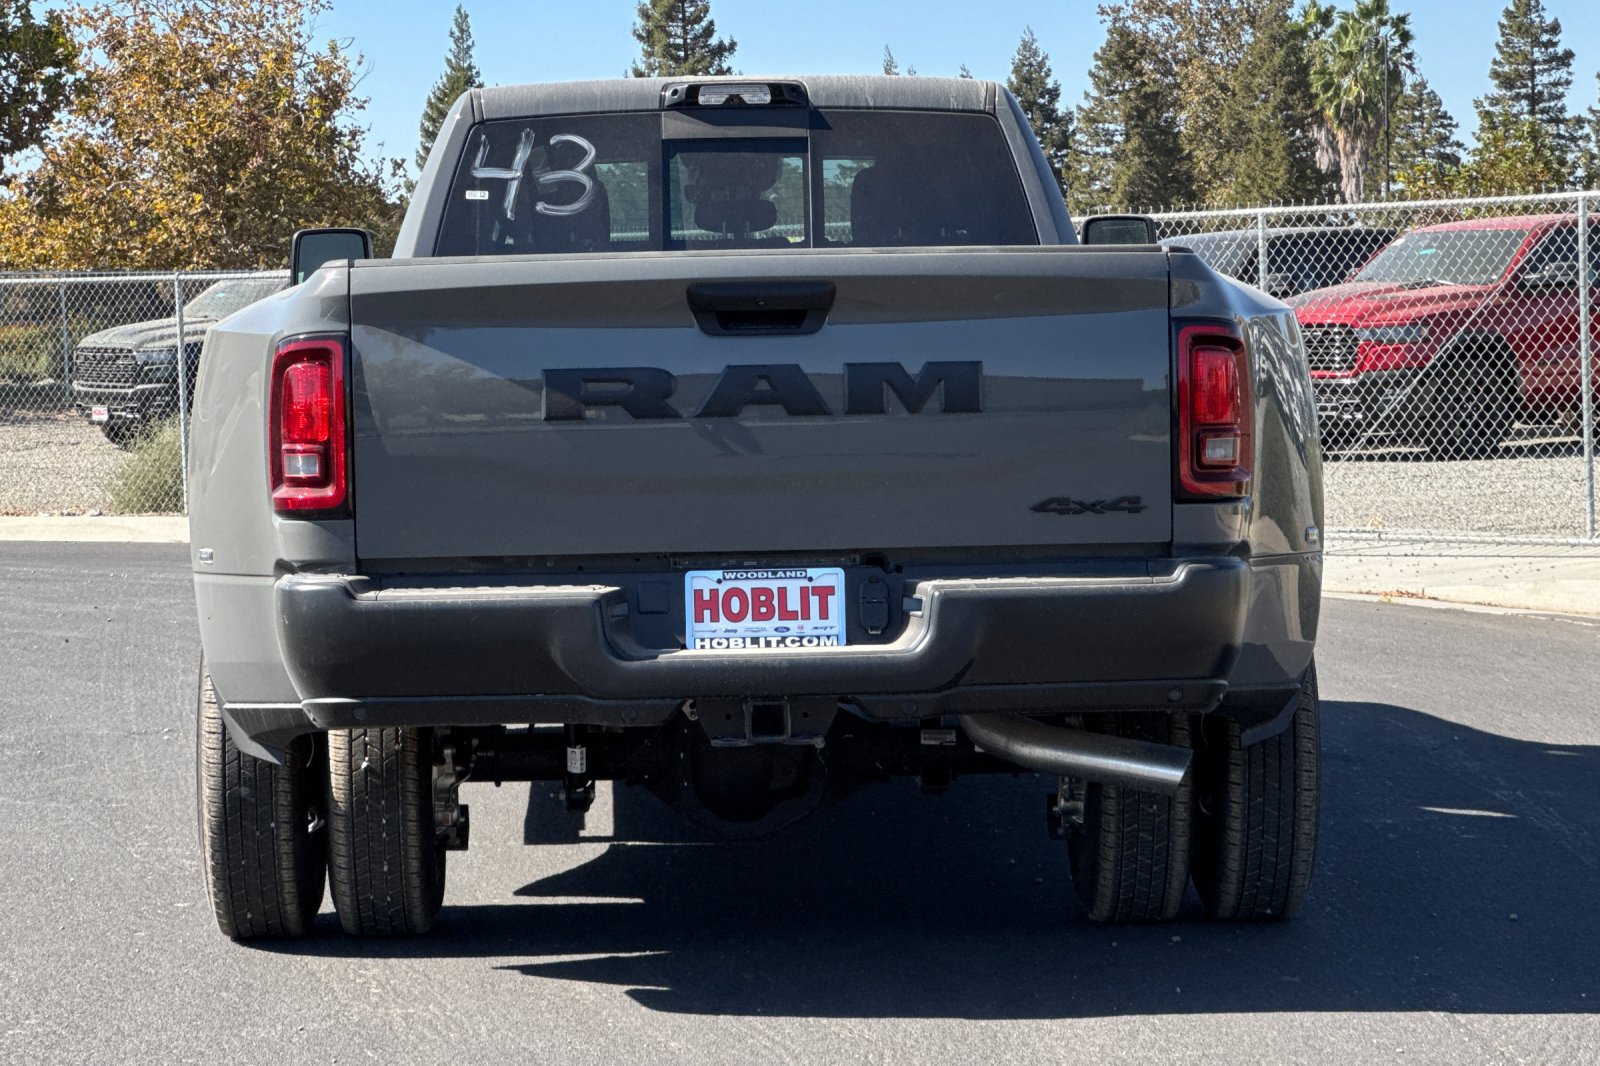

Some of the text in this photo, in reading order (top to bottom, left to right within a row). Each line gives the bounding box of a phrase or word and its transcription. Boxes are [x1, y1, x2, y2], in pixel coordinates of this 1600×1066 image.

[472, 128, 597, 221] 43
[541, 360, 985, 421] RAM
[1029, 495, 1149, 515] 4x4
[723, 570, 807, 579] WOODLAND
[693, 585, 836, 623] HOBLIT
[695, 636, 838, 649] HOBLIT.COM
